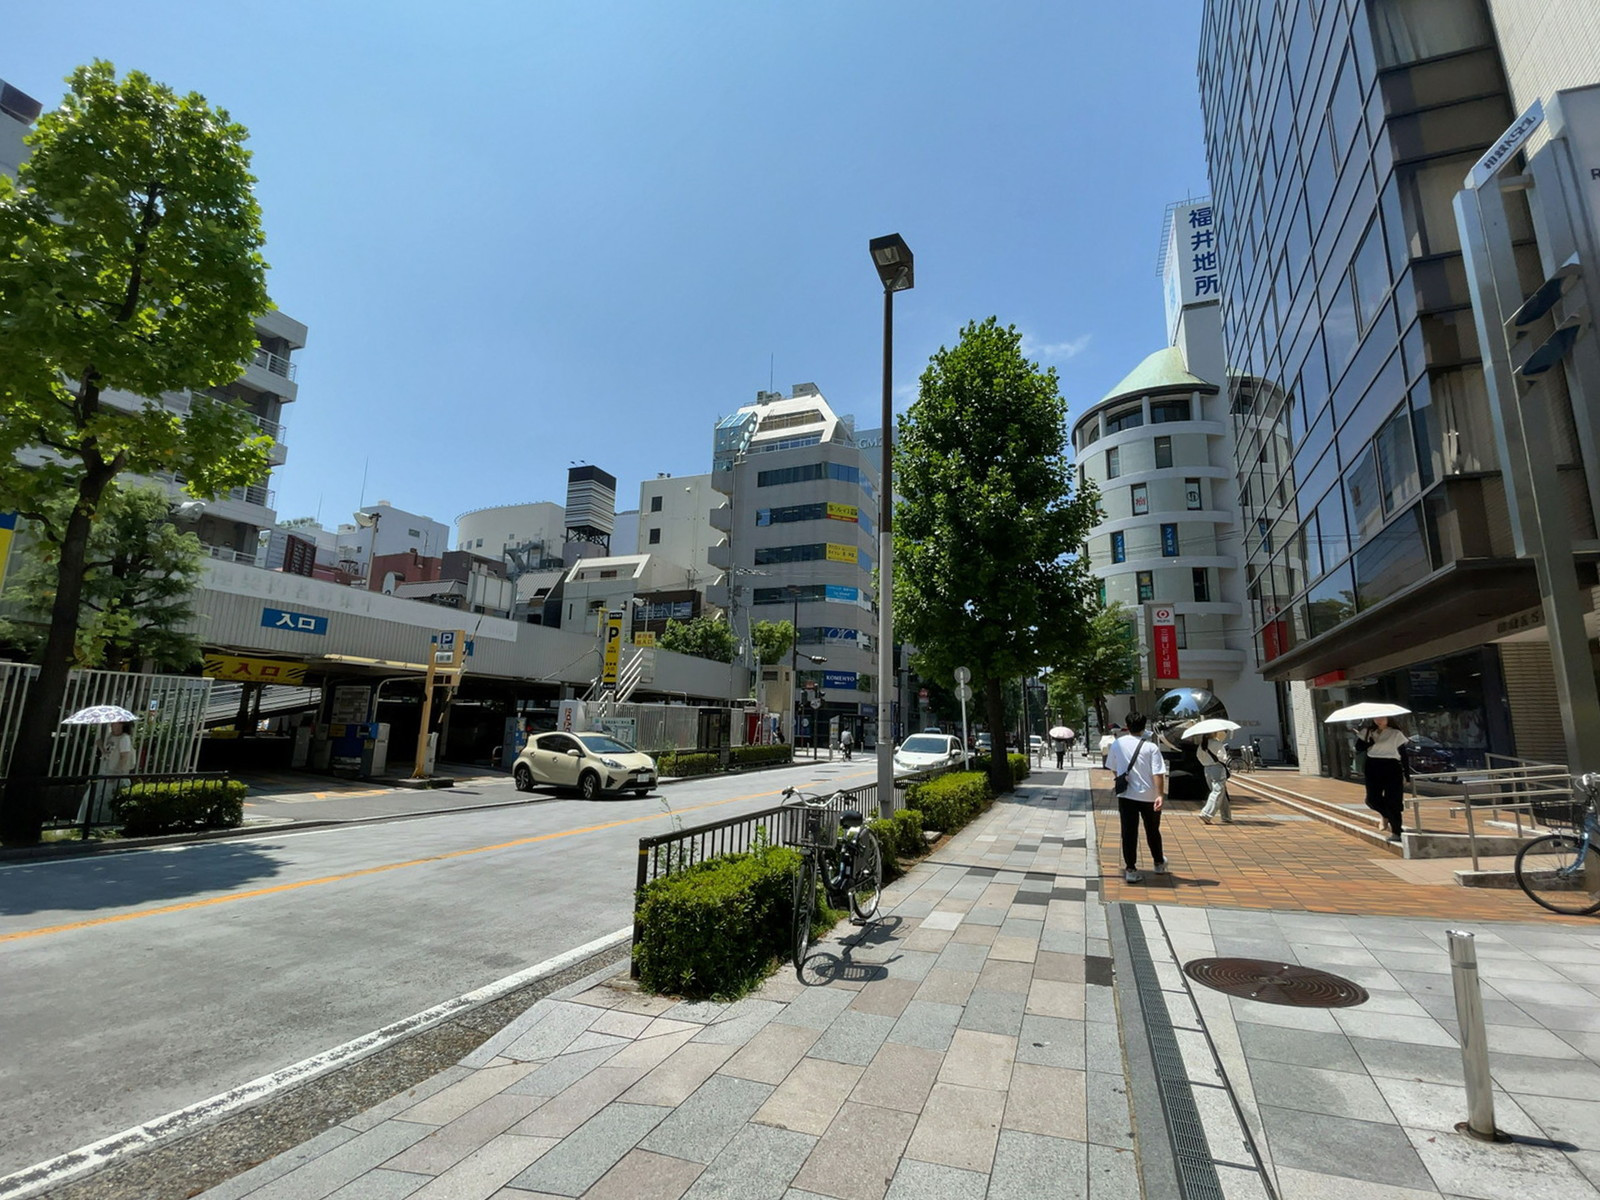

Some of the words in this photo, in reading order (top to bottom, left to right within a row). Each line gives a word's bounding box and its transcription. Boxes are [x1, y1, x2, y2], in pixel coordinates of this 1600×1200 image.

[1189, 206, 1220, 297] 福井地所
[275, 612, 316, 631] 入口
[442, 633, 453, 644] P
[608, 627, 620, 643] P
[1160, 628, 1172, 676] 三菱UFJ銀行
[232, 661, 281, 677] 入口
